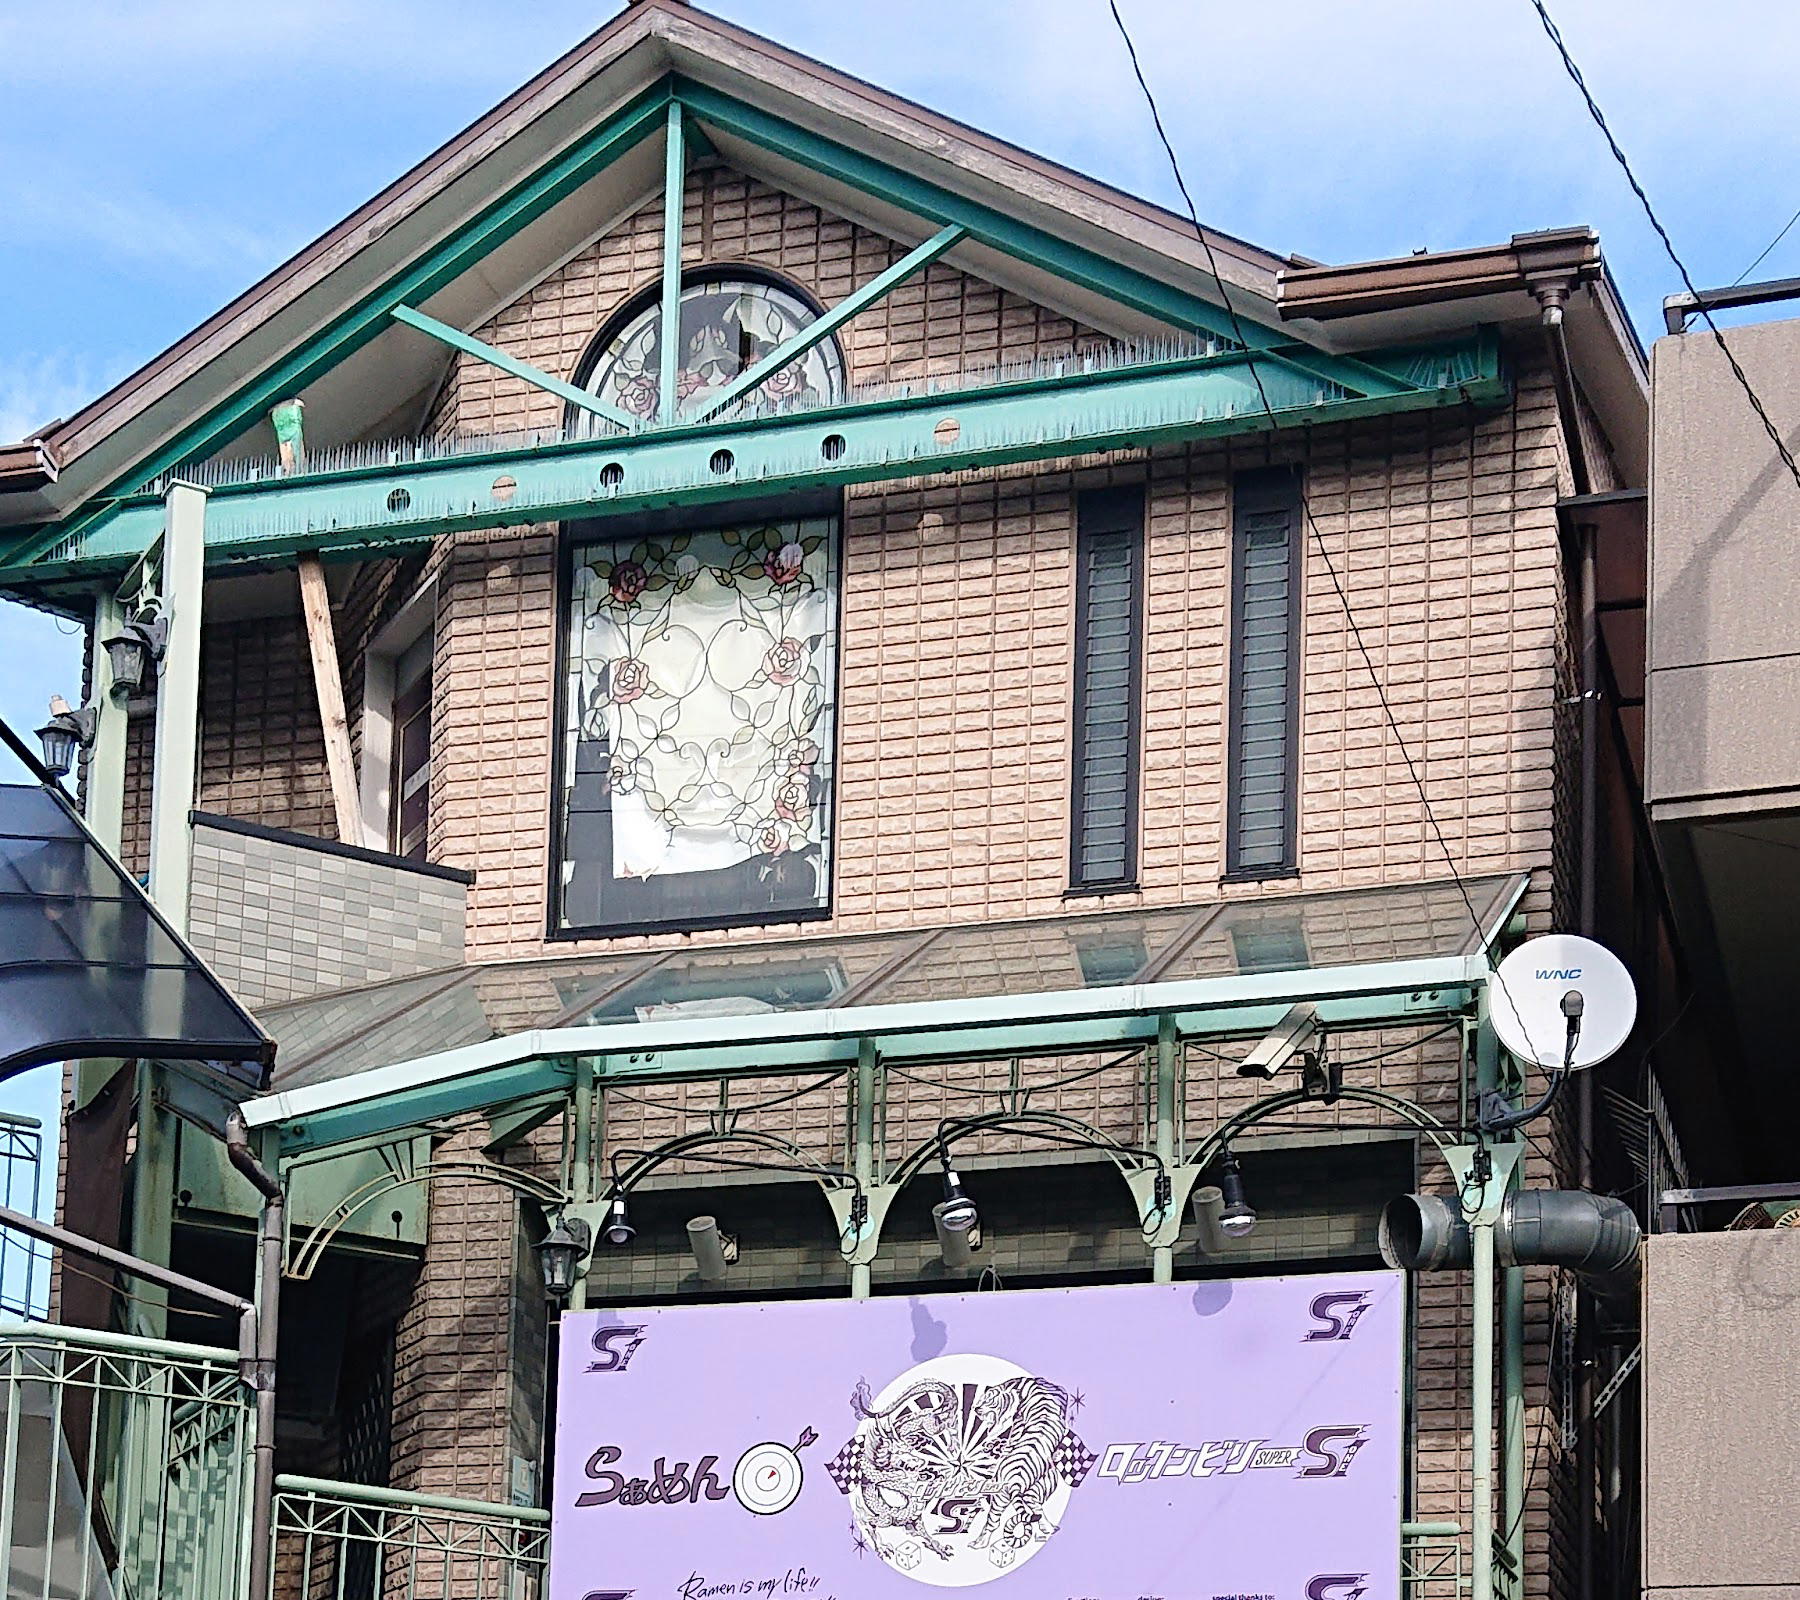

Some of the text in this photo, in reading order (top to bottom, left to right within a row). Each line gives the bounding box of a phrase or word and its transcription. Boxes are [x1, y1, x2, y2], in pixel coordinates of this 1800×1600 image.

[1535, 968, 1582, 980] WNC
[1254, 1449, 1293, 1467] SUPER
[739, 1578, 755, 1594] is
[757, 1578, 783, 1599] my
